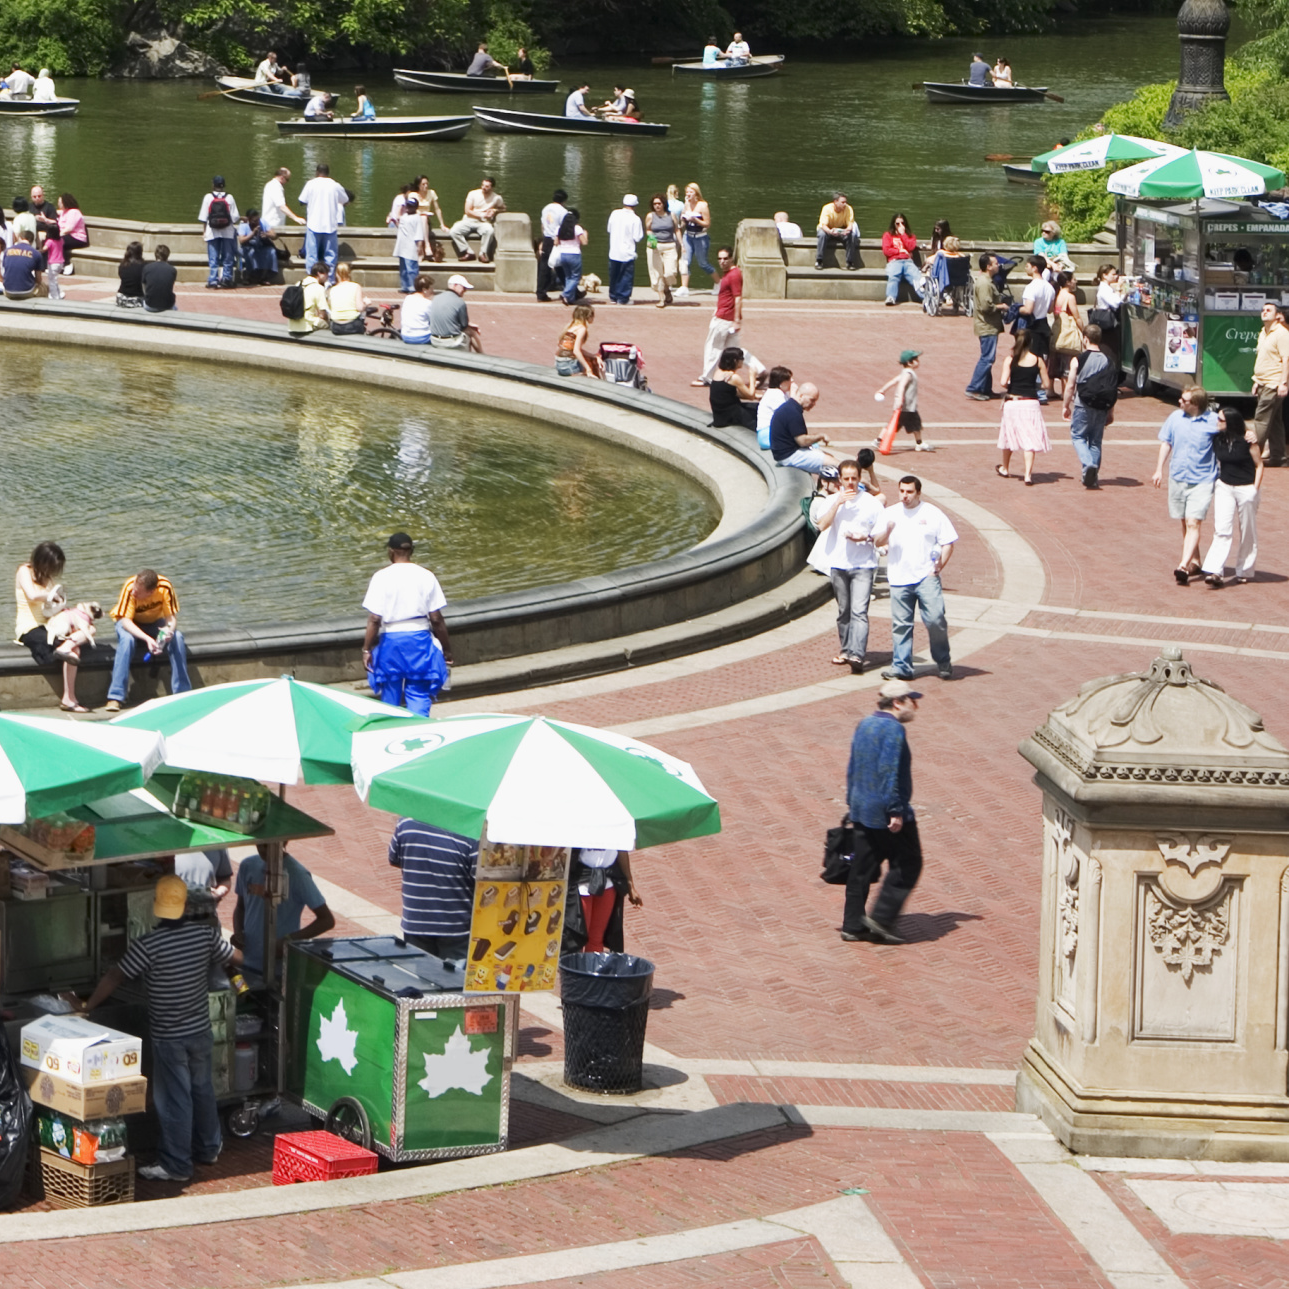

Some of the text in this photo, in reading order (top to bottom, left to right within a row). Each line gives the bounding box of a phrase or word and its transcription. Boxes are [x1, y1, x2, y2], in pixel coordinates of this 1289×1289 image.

[1210, 187, 1223, 196] KEEP
[1240, 185, 1259, 194] CLEAN
[1207, 223, 1238, 232] CREPES
